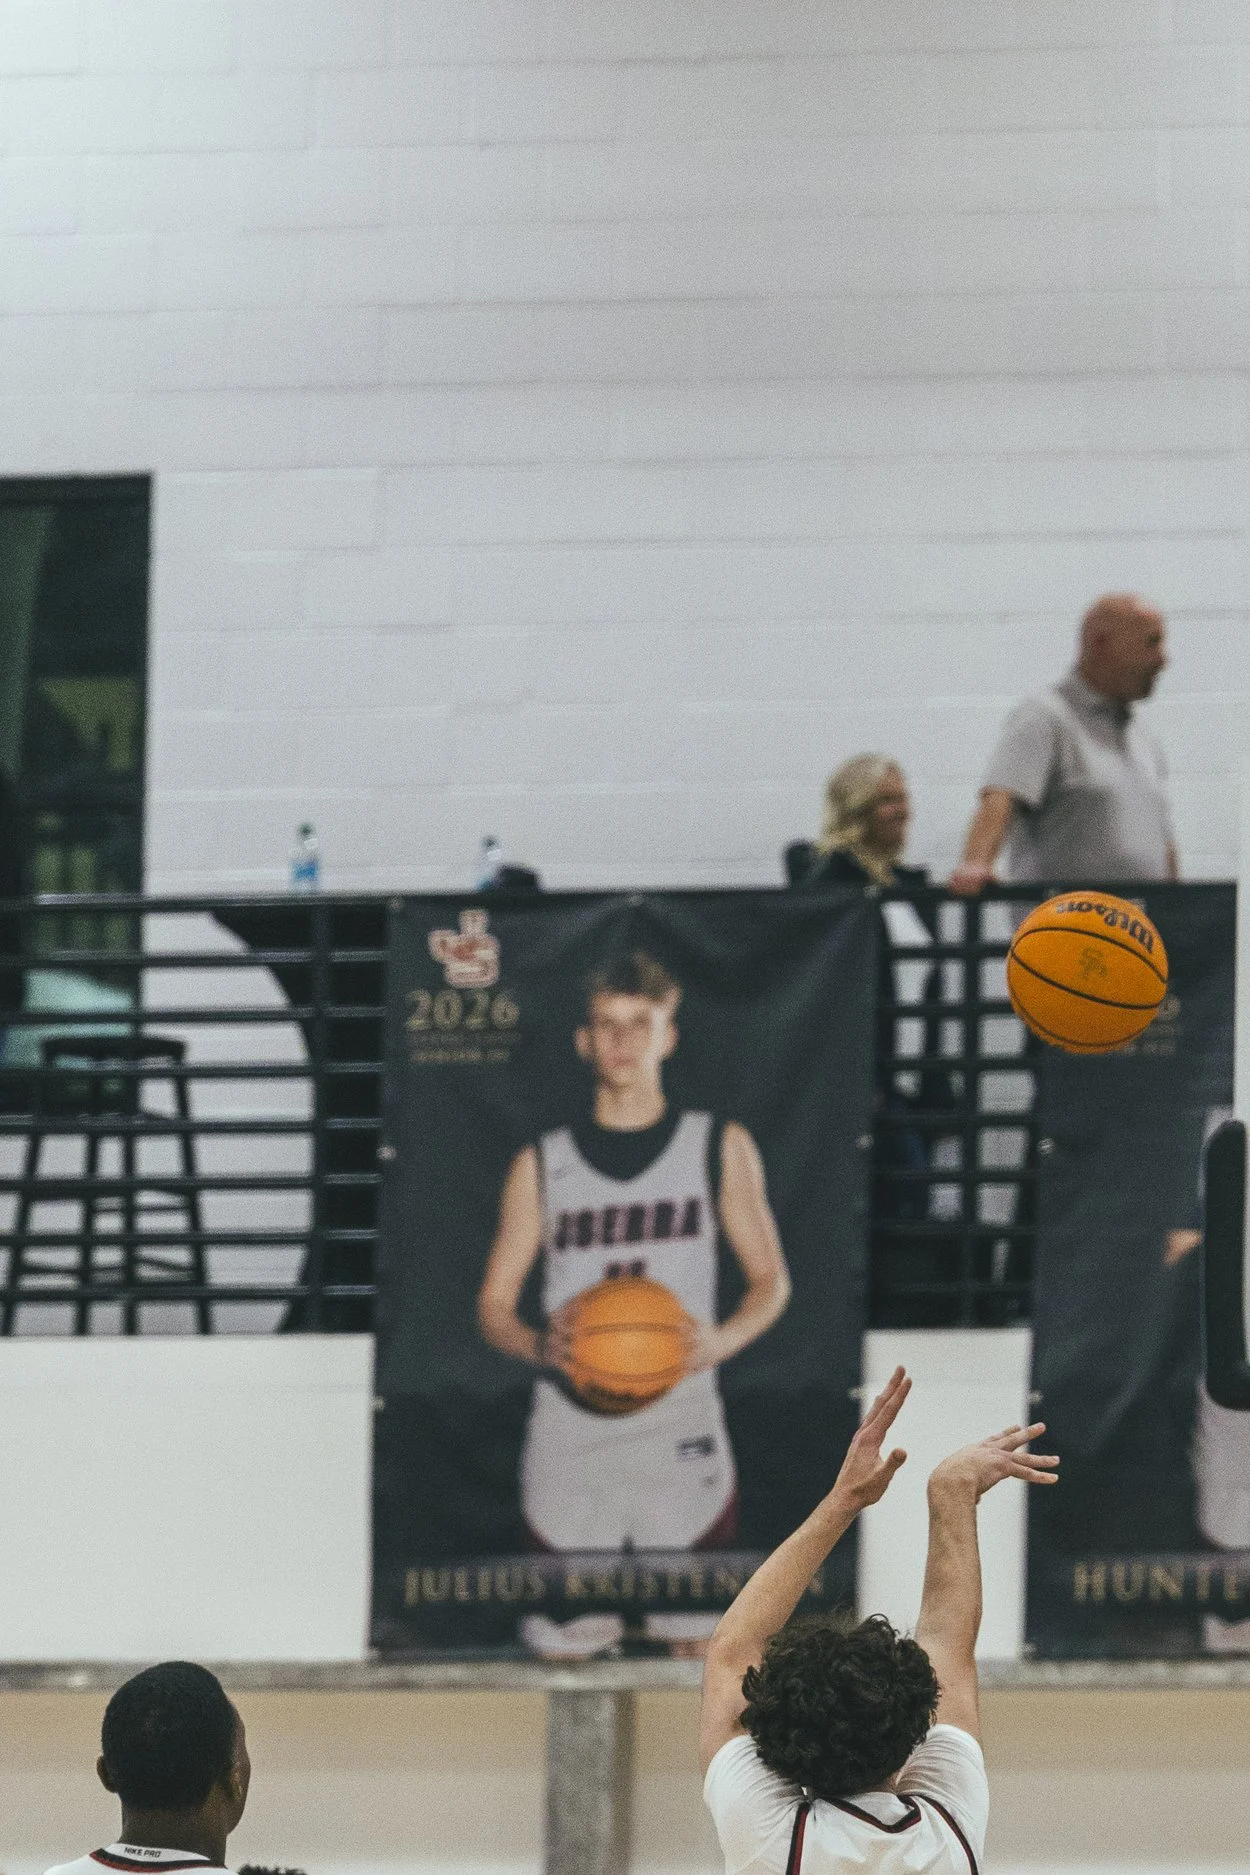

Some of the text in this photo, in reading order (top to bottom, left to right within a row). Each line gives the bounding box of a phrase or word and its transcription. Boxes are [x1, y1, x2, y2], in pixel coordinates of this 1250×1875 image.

[404, 987, 521, 1031] 2026
[405, 1565, 547, 1607] JULIUS
[124, 1846, 161, 1858] NIKE PRO
